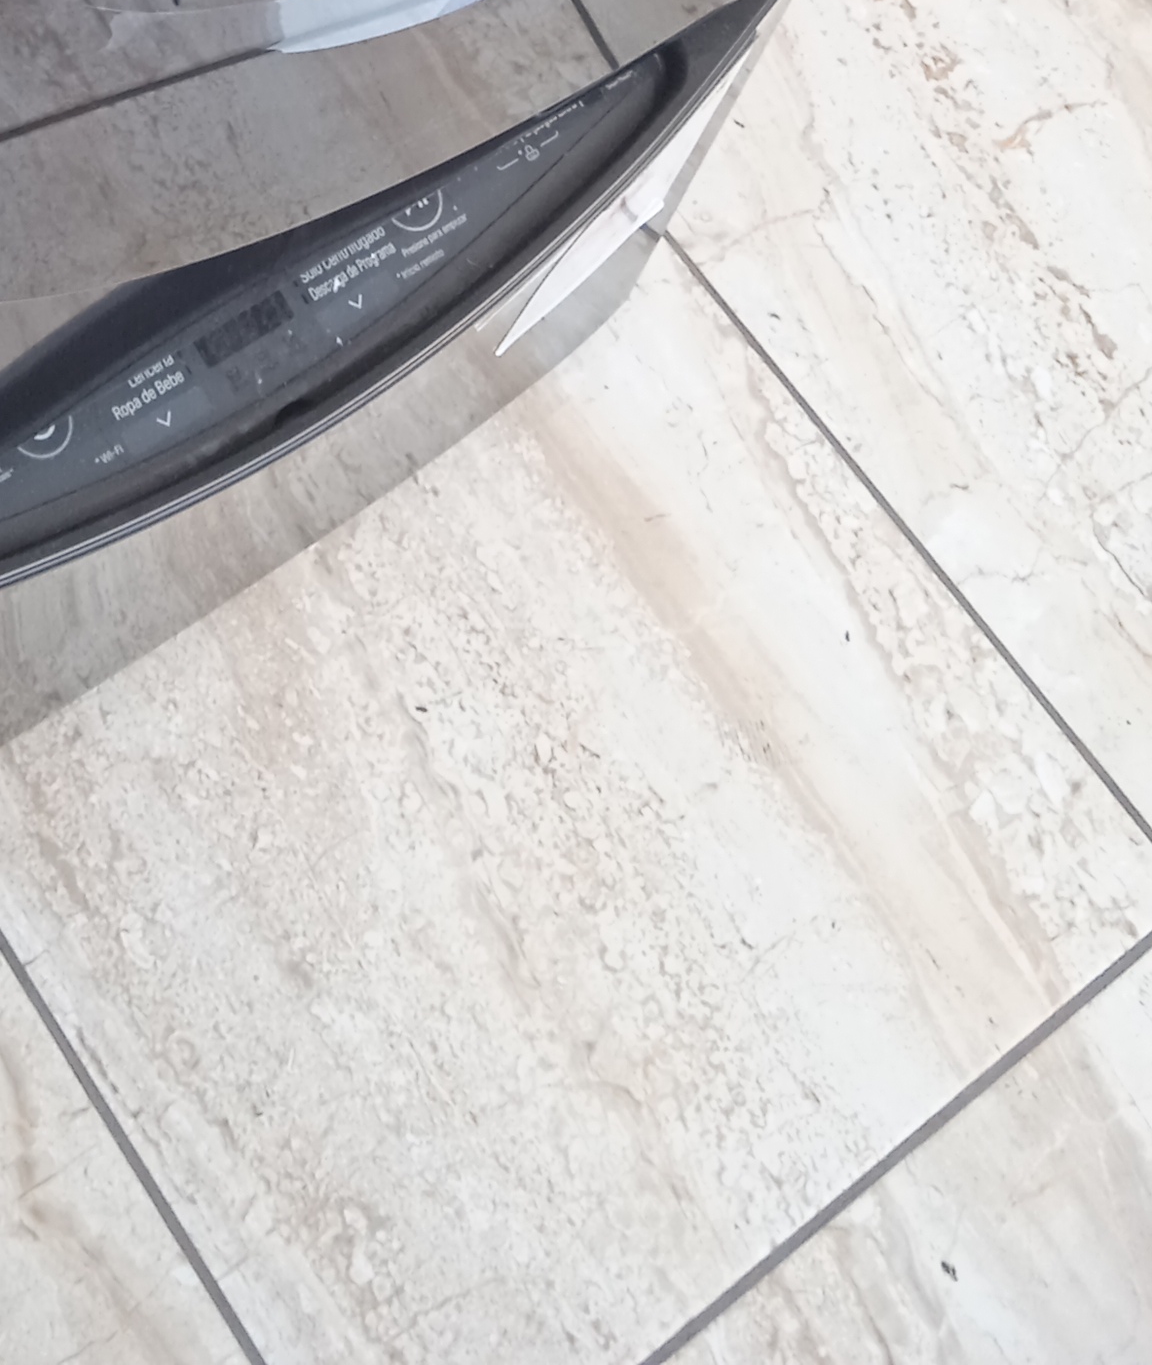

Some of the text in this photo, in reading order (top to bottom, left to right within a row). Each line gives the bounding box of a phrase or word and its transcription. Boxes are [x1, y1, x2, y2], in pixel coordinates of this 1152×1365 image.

[355, 242, 396, 273] Programa
[111, 397, 143, 421] Ropa
[141, 388, 157, 404] de
